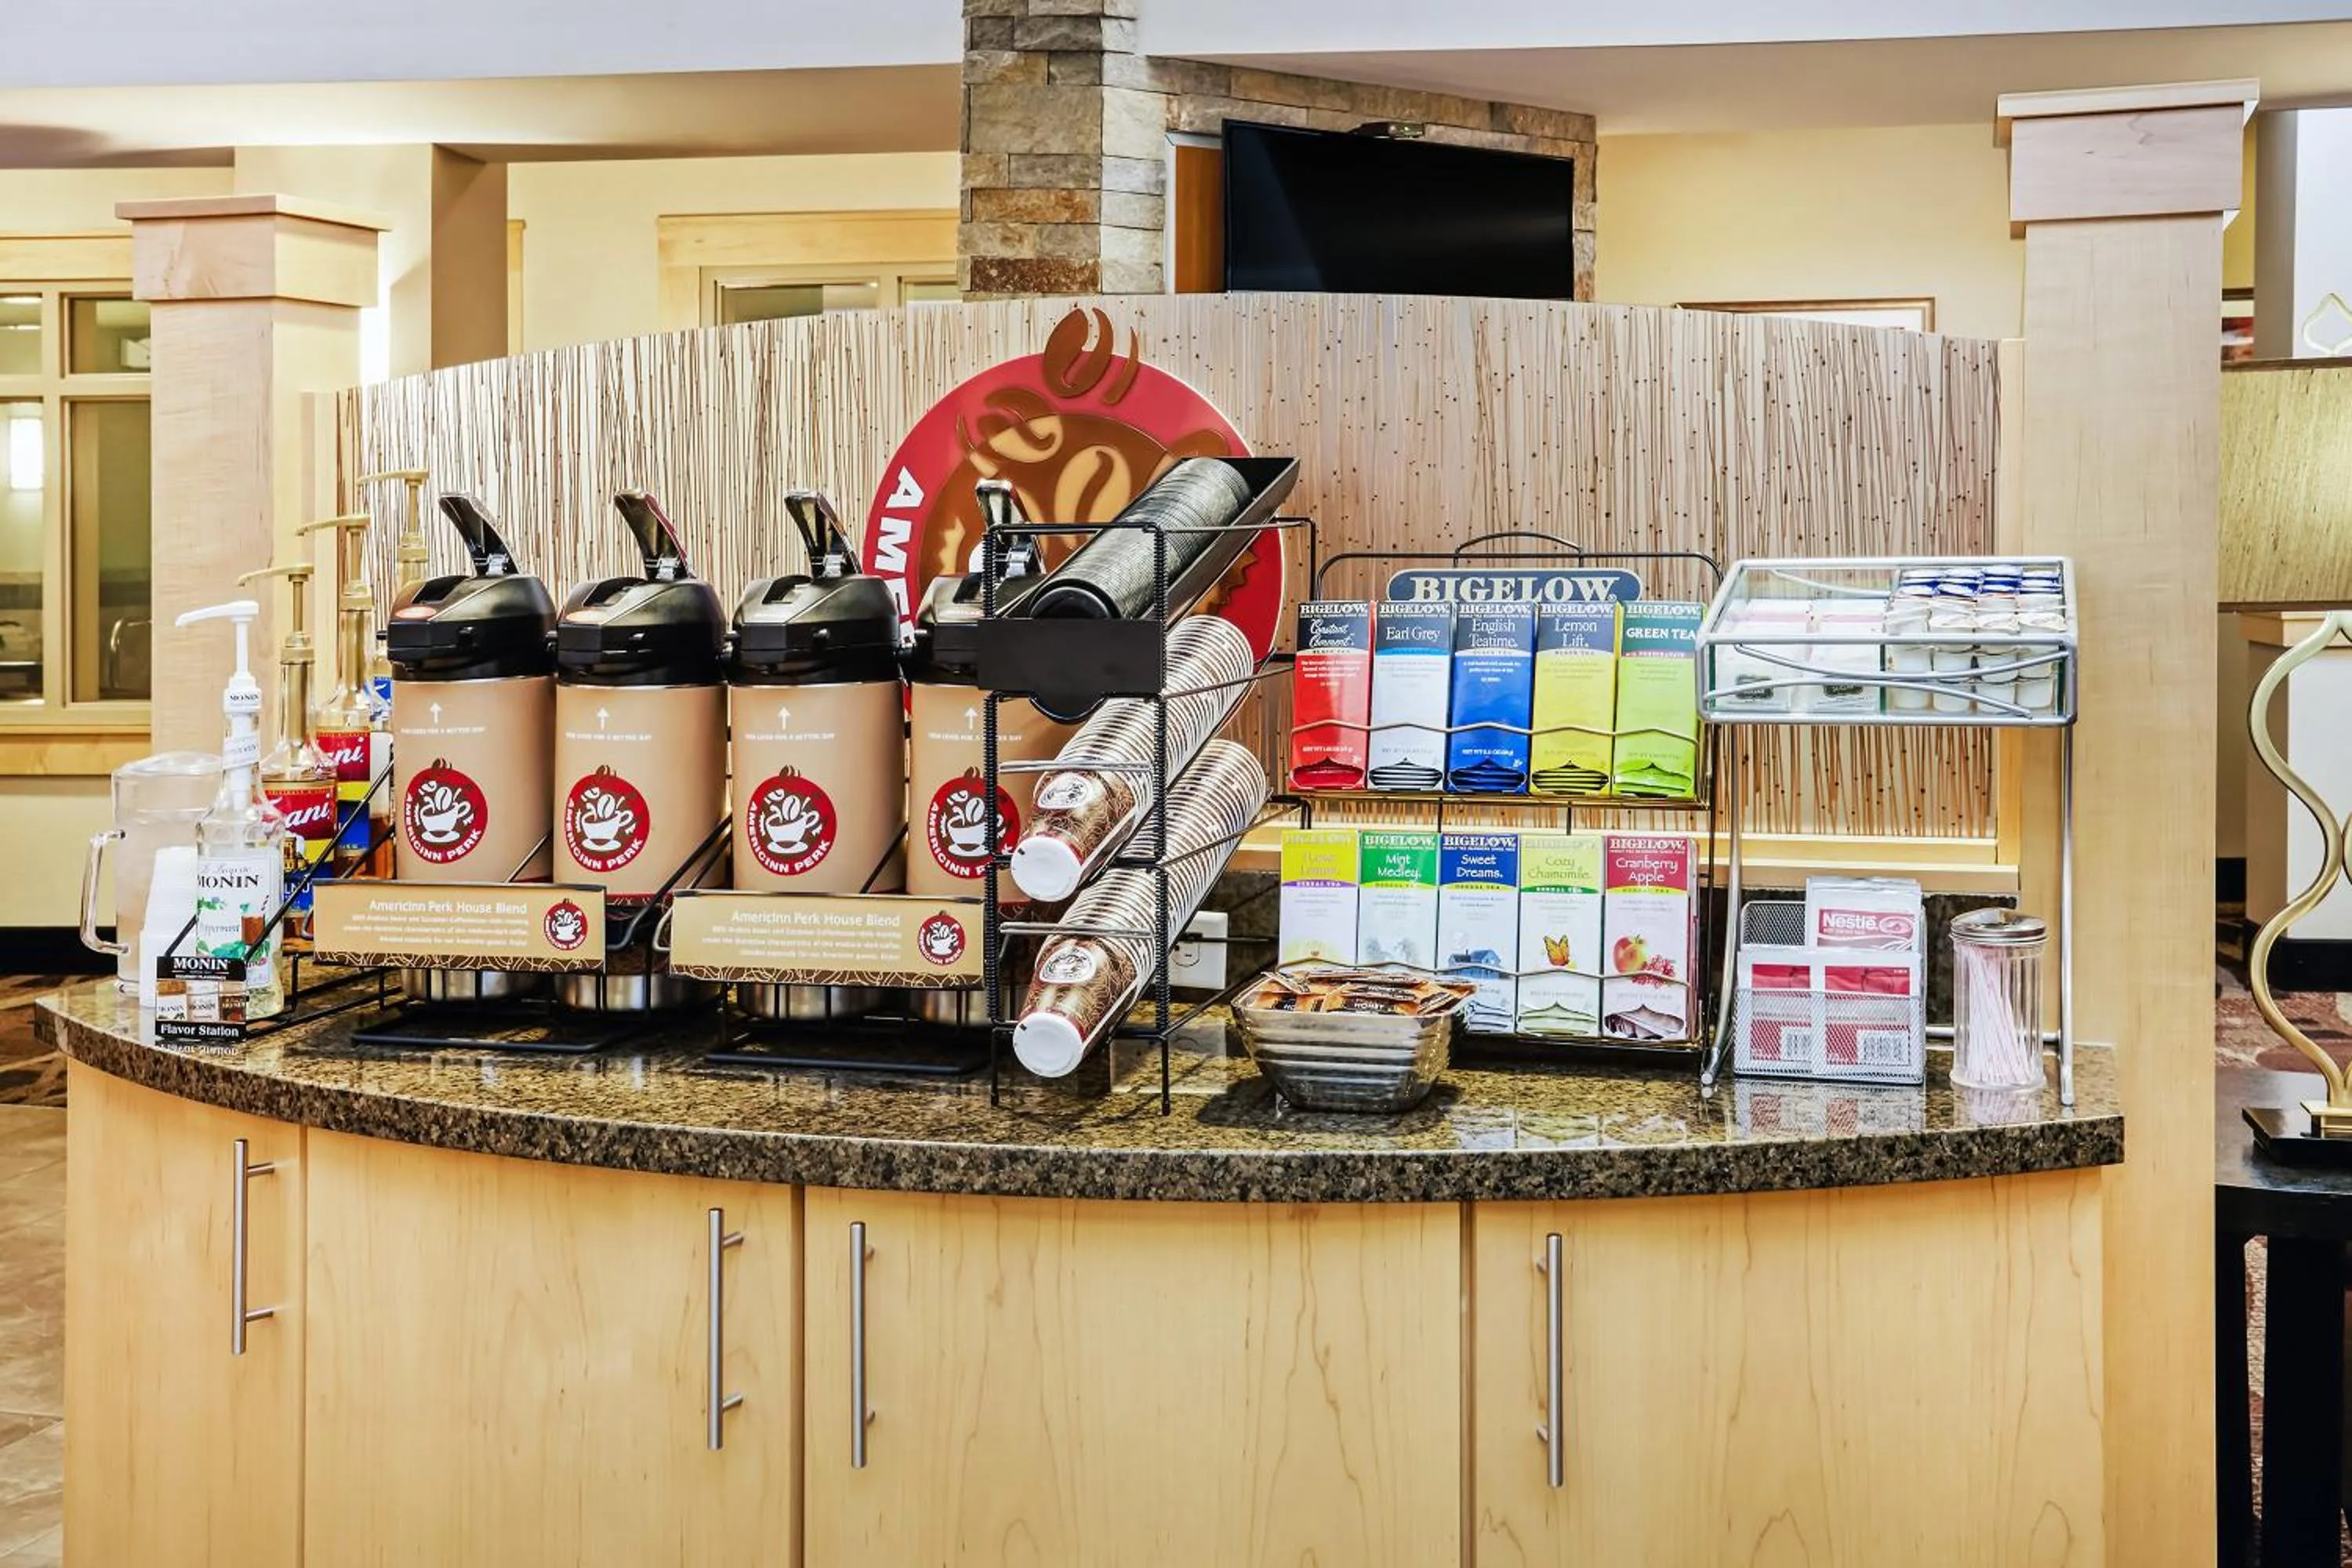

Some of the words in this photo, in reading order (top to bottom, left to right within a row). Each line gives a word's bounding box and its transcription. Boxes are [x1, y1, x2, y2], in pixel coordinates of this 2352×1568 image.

[1410, 576, 1621, 602] BIGELOW
[1300, 603, 1368, 614] BIGELOW
[1380, 603, 1450, 614] BIGELOW
[1460, 603, 1530, 614] BIGELOW
[1540, 603, 1613, 614] BIGELOW
[1472, 619, 1515, 634] English
[1555, 618, 1597, 632] Lemon
[1385, 626, 1410, 641] Earl
[1412, 626, 1440, 642] Grey
[1626, 627, 1668, 639] GREEN
[1671, 629, 1696, 640] TEA
[749, 800, 789, 873] AMERICINN
[794, 839, 830, 872] PERK
[929, 801, 971, 876] AMERICINN
[1365, 836, 1435, 847] BIGELOW
[1443, 836, 1516, 847] BIGELOW
[446, 828, 482, 861] PERK
[1610, 838, 1686, 850] BIGELOW
[606, 837, 643, 869] PERK
[1386, 852, 1411, 865] Mint
[1461, 854, 1496, 865] Sweet
[1544, 856, 1575, 870] Cozy
[1616, 854, 1679, 874] Cranberry
[1628, 869, 1664, 886] Apple
[428, 900, 453, 913] Perk
[456, 902, 492, 914] House
[495, 902, 528, 915] Blend
[793, 911, 821, 925] Perk
[824, 913, 863, 927] House
[866, 914, 901, 927] Blend
[173, 957, 228, 970] MONIN
[161, 1024, 195, 1035] Flavor
[198, 1025, 239, 1037] Station
